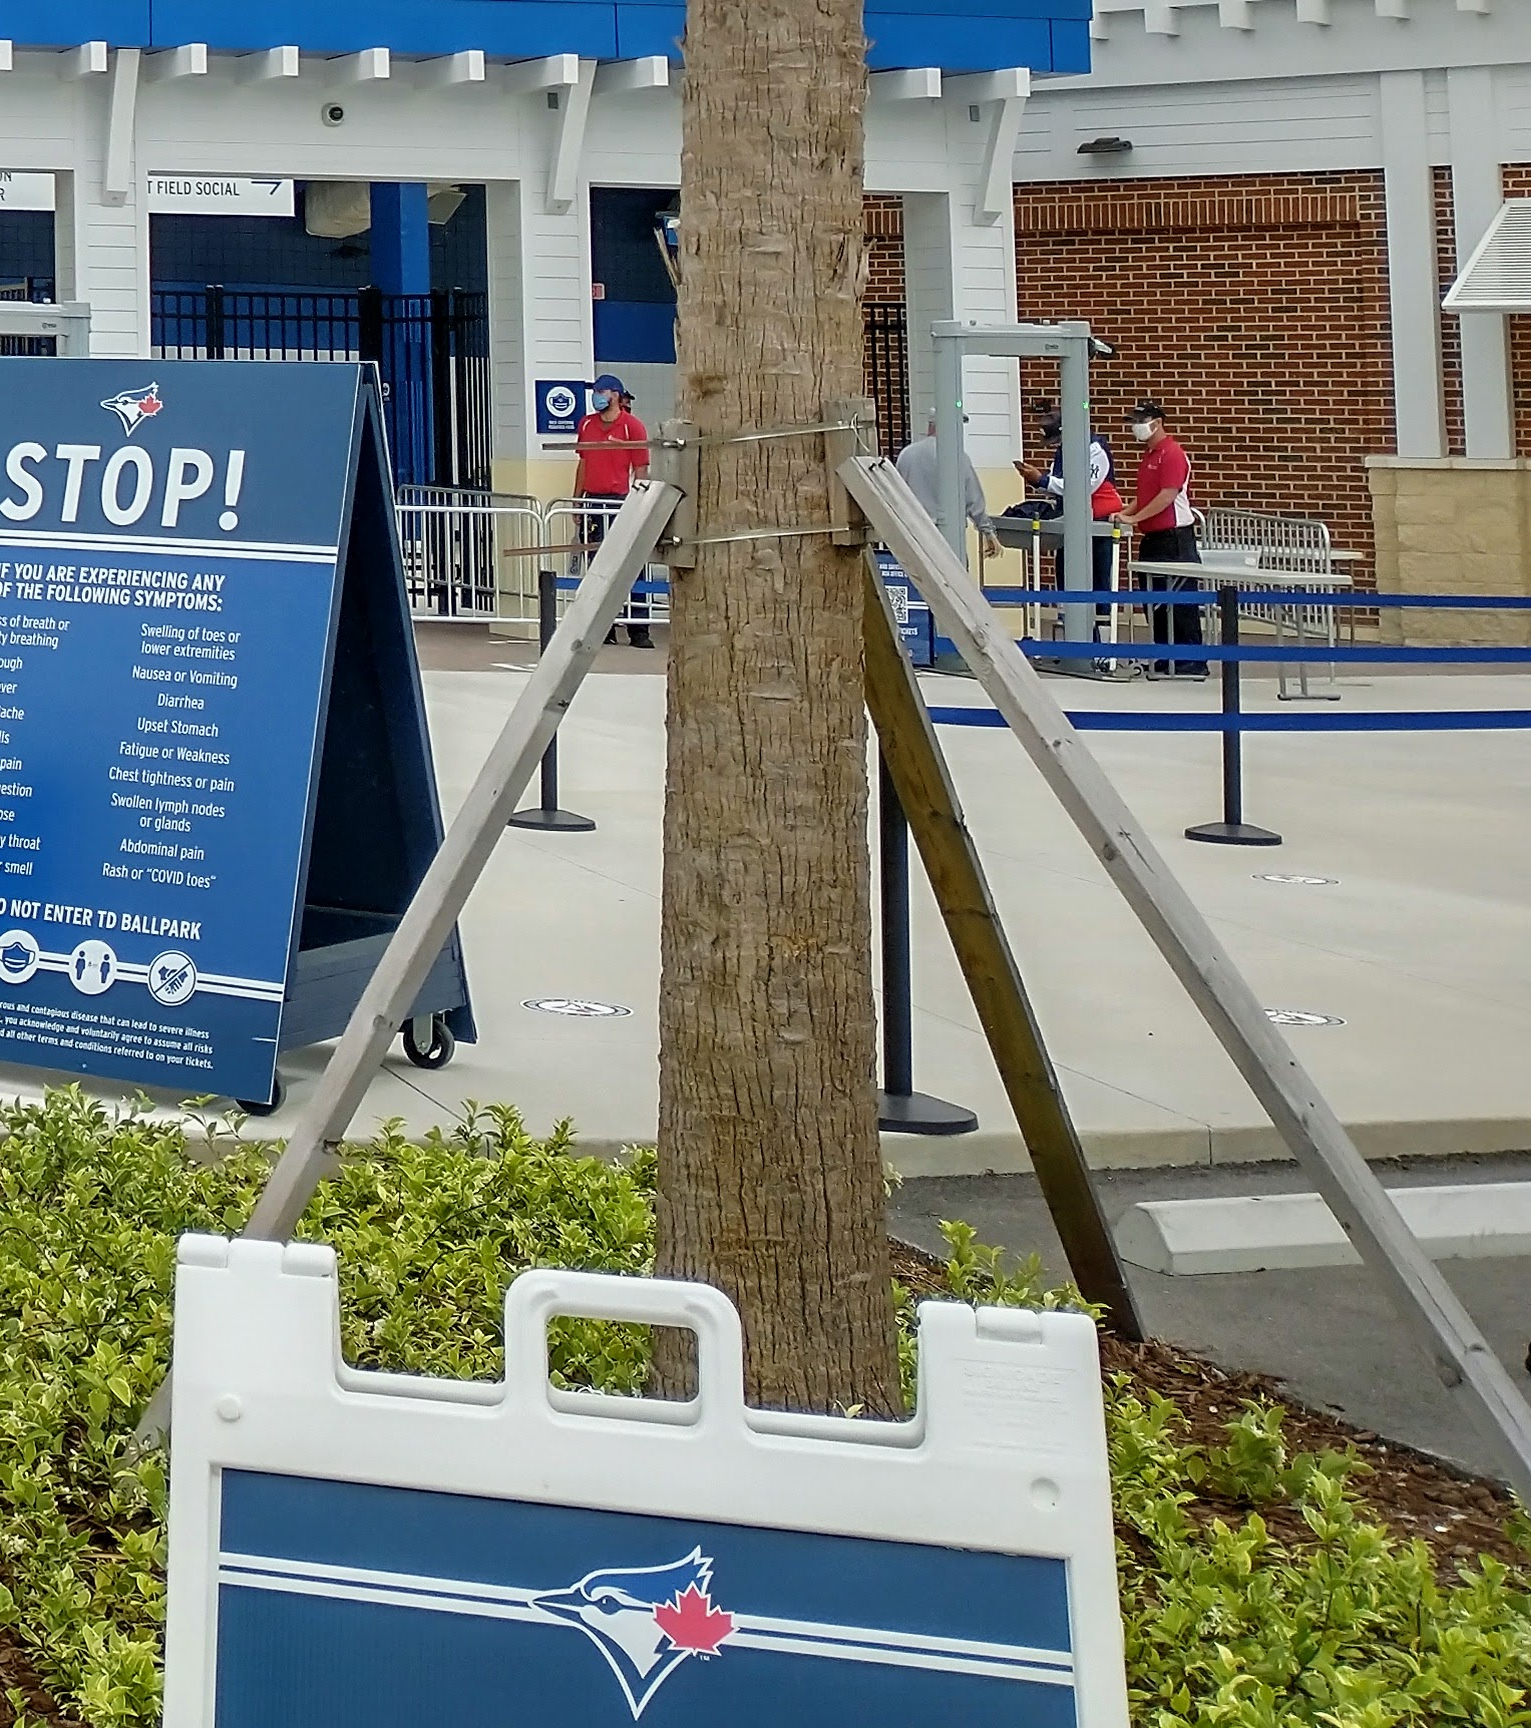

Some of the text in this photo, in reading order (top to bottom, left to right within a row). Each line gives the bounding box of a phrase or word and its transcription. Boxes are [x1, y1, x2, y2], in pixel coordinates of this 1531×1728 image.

[157, 180, 192, 195] FIELD
[196, 182, 240, 196] SOCIAL
[14, 563, 43, 580] YOU
[45, 565, 76, 582] ARE
[78, 566, 188, 589] EXPERIENCING
[191, 573, 225, 591] ANY
[15, 582, 43, 599] THE
[46, 584, 130, 605] FOLLOWING
[133, 589, 222, 611] SYMPTOMS:
[140, 623, 241, 642] Swelling of toes or
[141, 640, 235, 660] lower extremities
[132, 665, 237, 689] Nausea or Vomiting
[157, 693, 204, 709] Diarrhea
[137, 717, 218, 737] Upset Stomach
[119, 741, 229, 764] Fatigue or Weakness
[109, 766, 234, 792] Chest tightness or pain
[10, 899, 41, 919] NOT
[43, 903, 93, 926] ENTER
[97, 910, 117, 928] TD
[120, 913, 201, 940] BALLPARK
